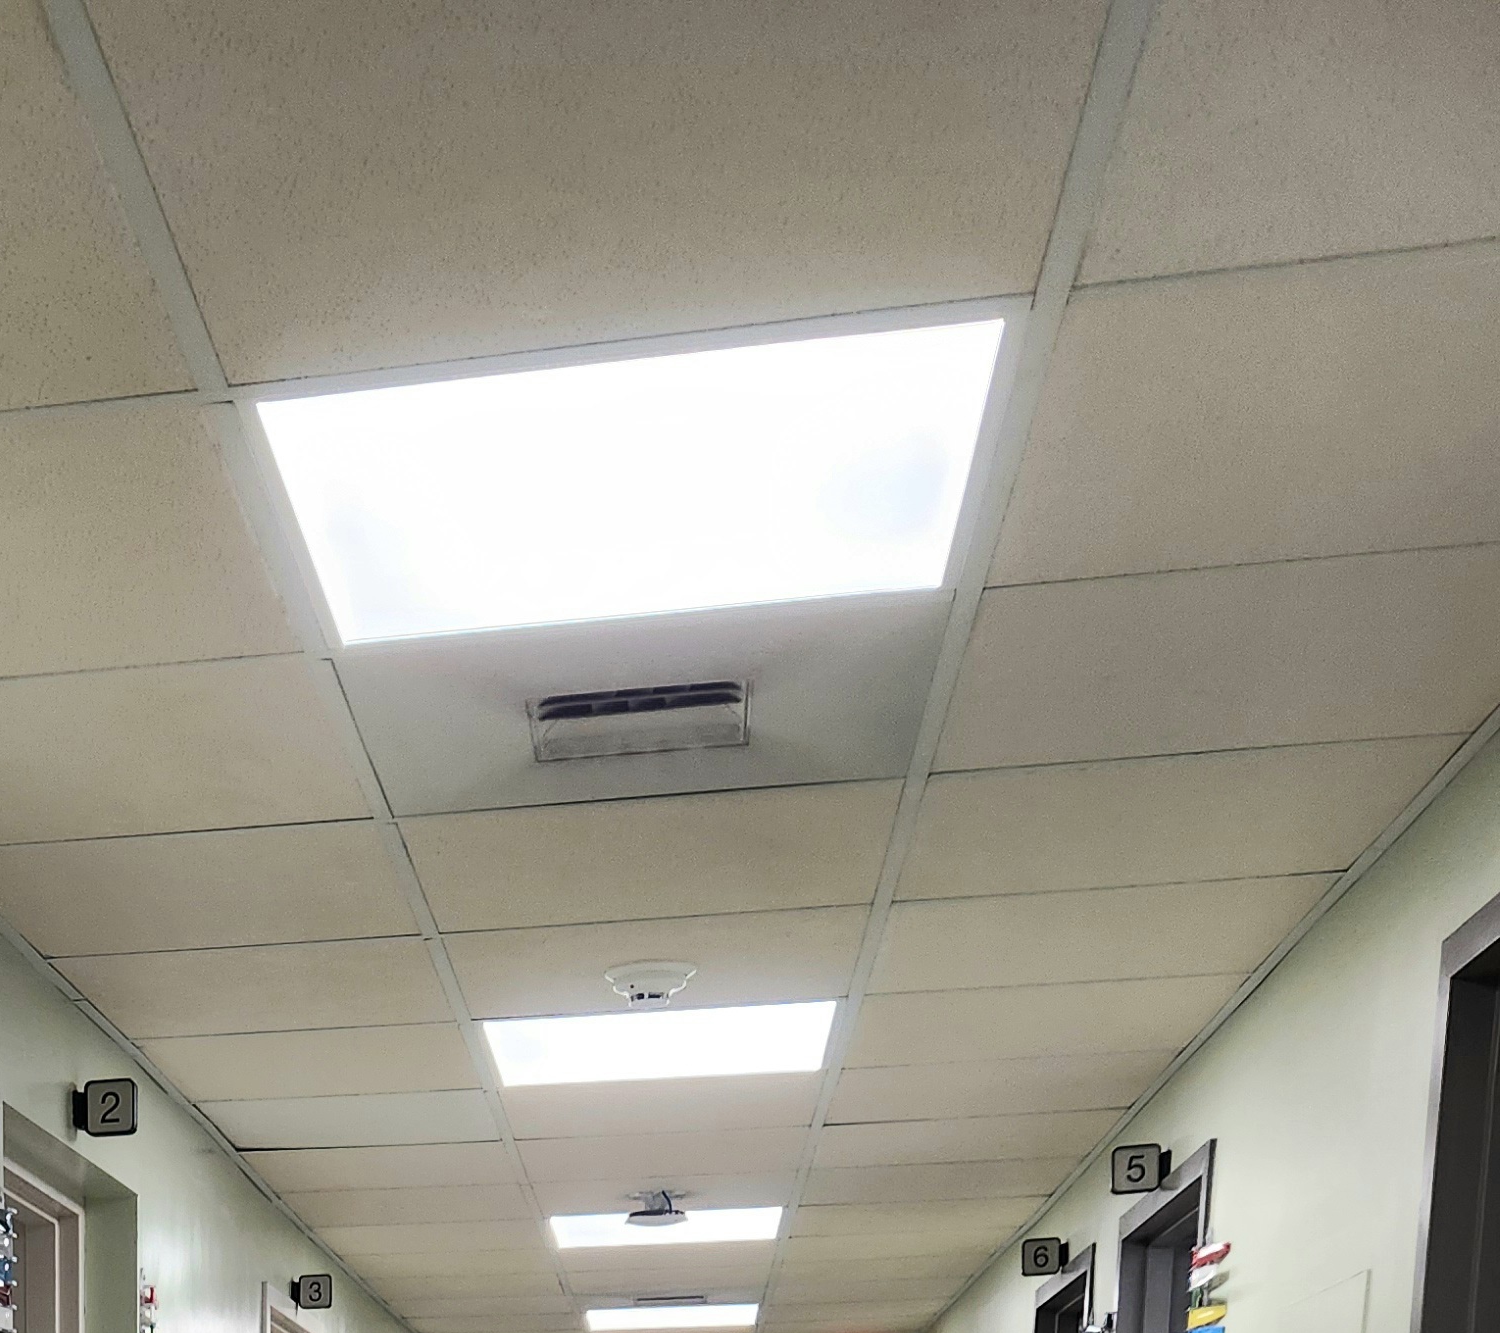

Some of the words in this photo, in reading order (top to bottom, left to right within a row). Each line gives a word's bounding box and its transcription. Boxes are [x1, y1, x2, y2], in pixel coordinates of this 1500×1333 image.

[100, 1091, 121, 1124] 2
[1126, 1154, 1147, 1183] 5
[1033, 1245, 1049, 1269] 6
[308, 1281, 323, 1302] 3
